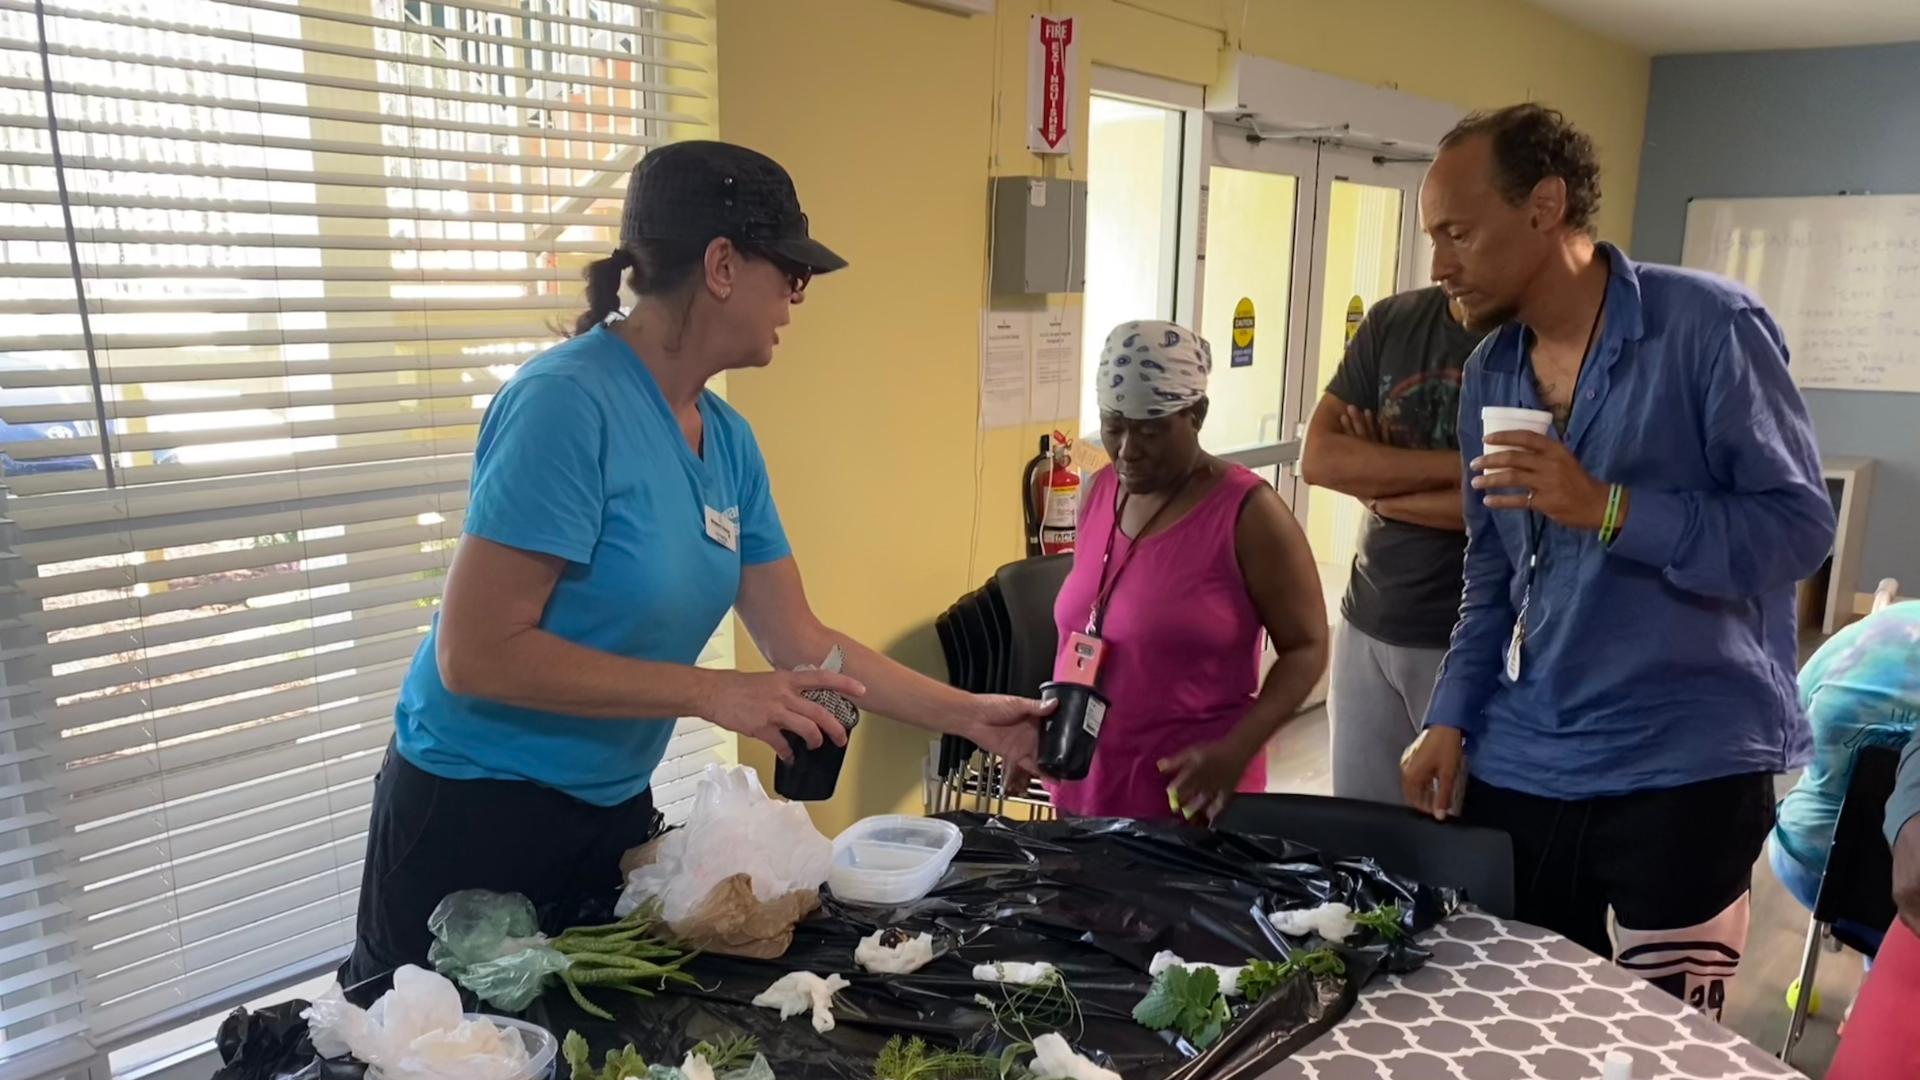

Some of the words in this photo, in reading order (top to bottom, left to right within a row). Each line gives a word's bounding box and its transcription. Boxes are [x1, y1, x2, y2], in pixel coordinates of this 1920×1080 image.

[1045, 24, 1067, 39] FIRE
[1048, 41, 1060, 141] EXTINGUISHER
[1234, 318, 1254, 328] CAUTION
